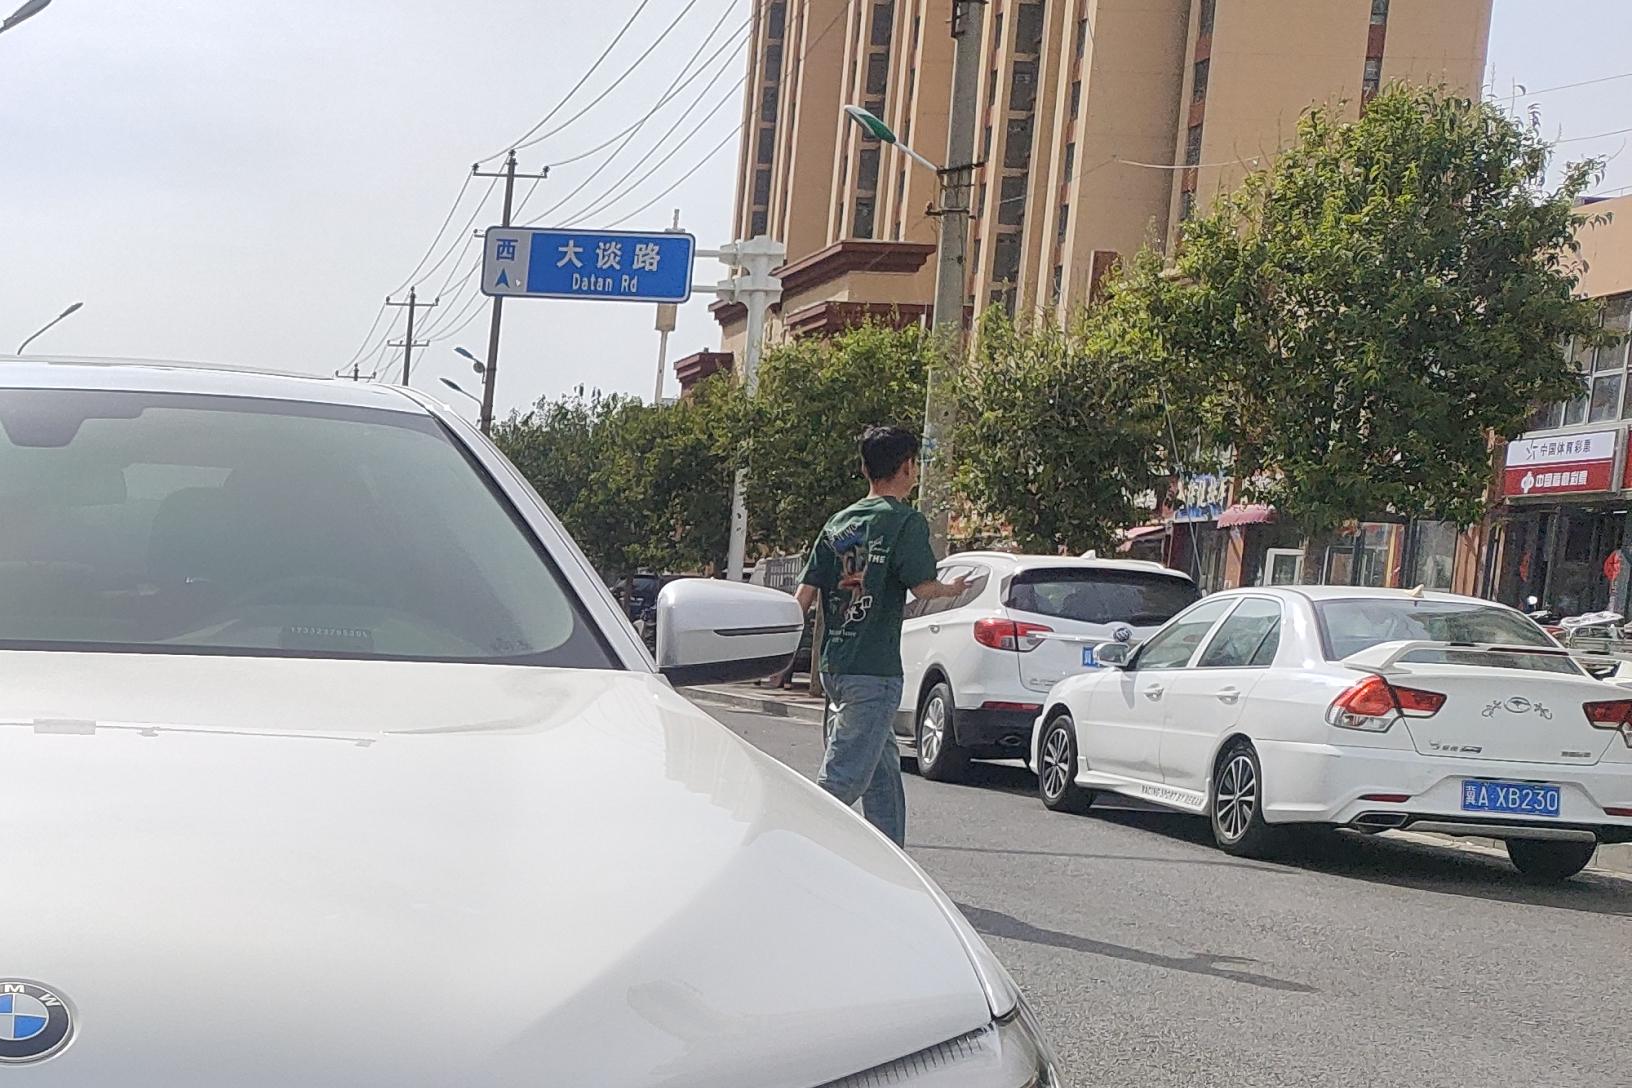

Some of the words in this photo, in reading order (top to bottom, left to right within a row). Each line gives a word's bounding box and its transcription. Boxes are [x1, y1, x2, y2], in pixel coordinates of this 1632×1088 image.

[495, 239, 518, 262] 西
[557, 240, 661, 271] 大谈路
[572, 273, 613, 292] Datan
[621, 274, 638, 293] Rd
